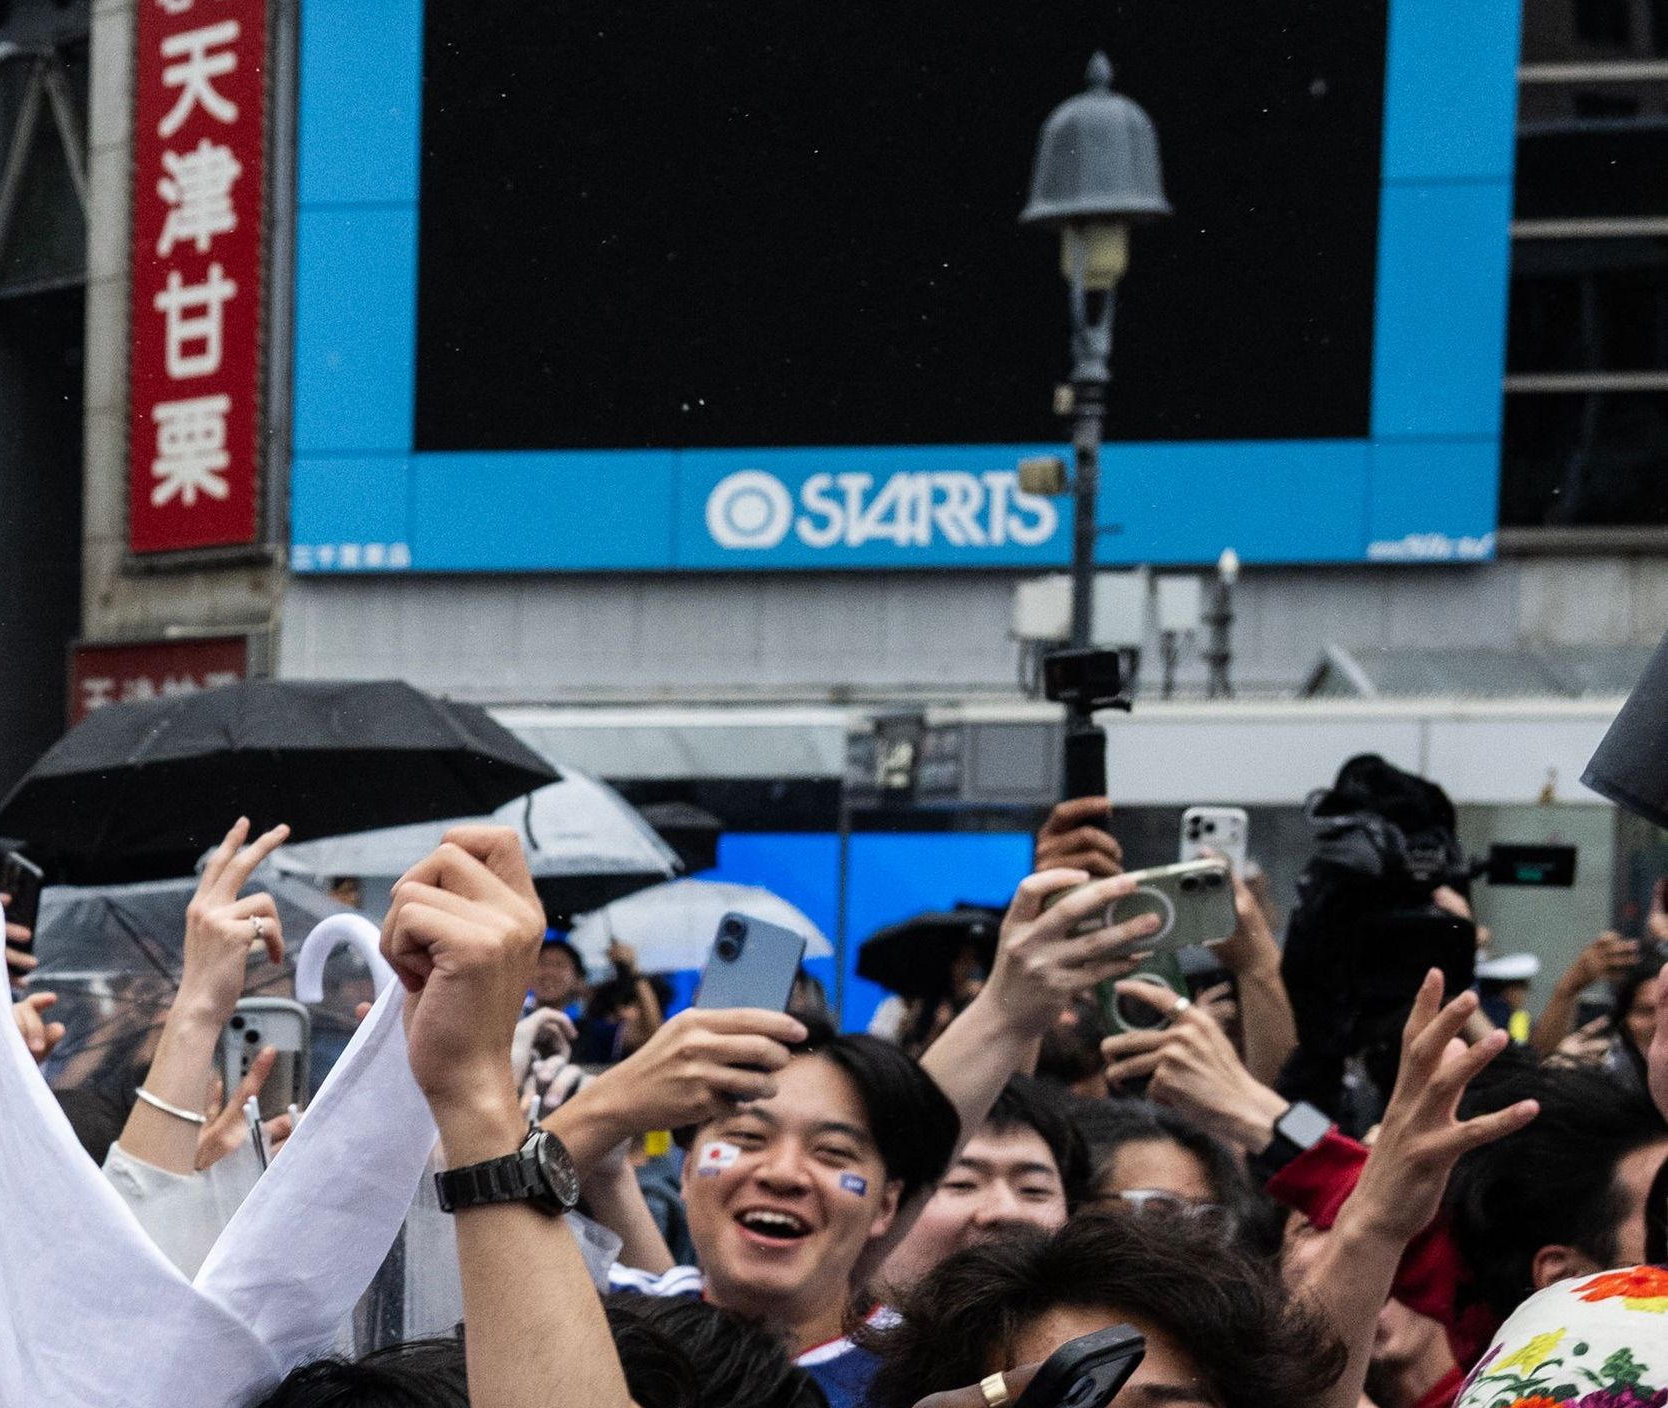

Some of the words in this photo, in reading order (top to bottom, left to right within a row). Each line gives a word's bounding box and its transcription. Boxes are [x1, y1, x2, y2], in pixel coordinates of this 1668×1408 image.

[149, 0, 242, 507] 天津甘栗
[795, 471, 1059, 549] STARTS
